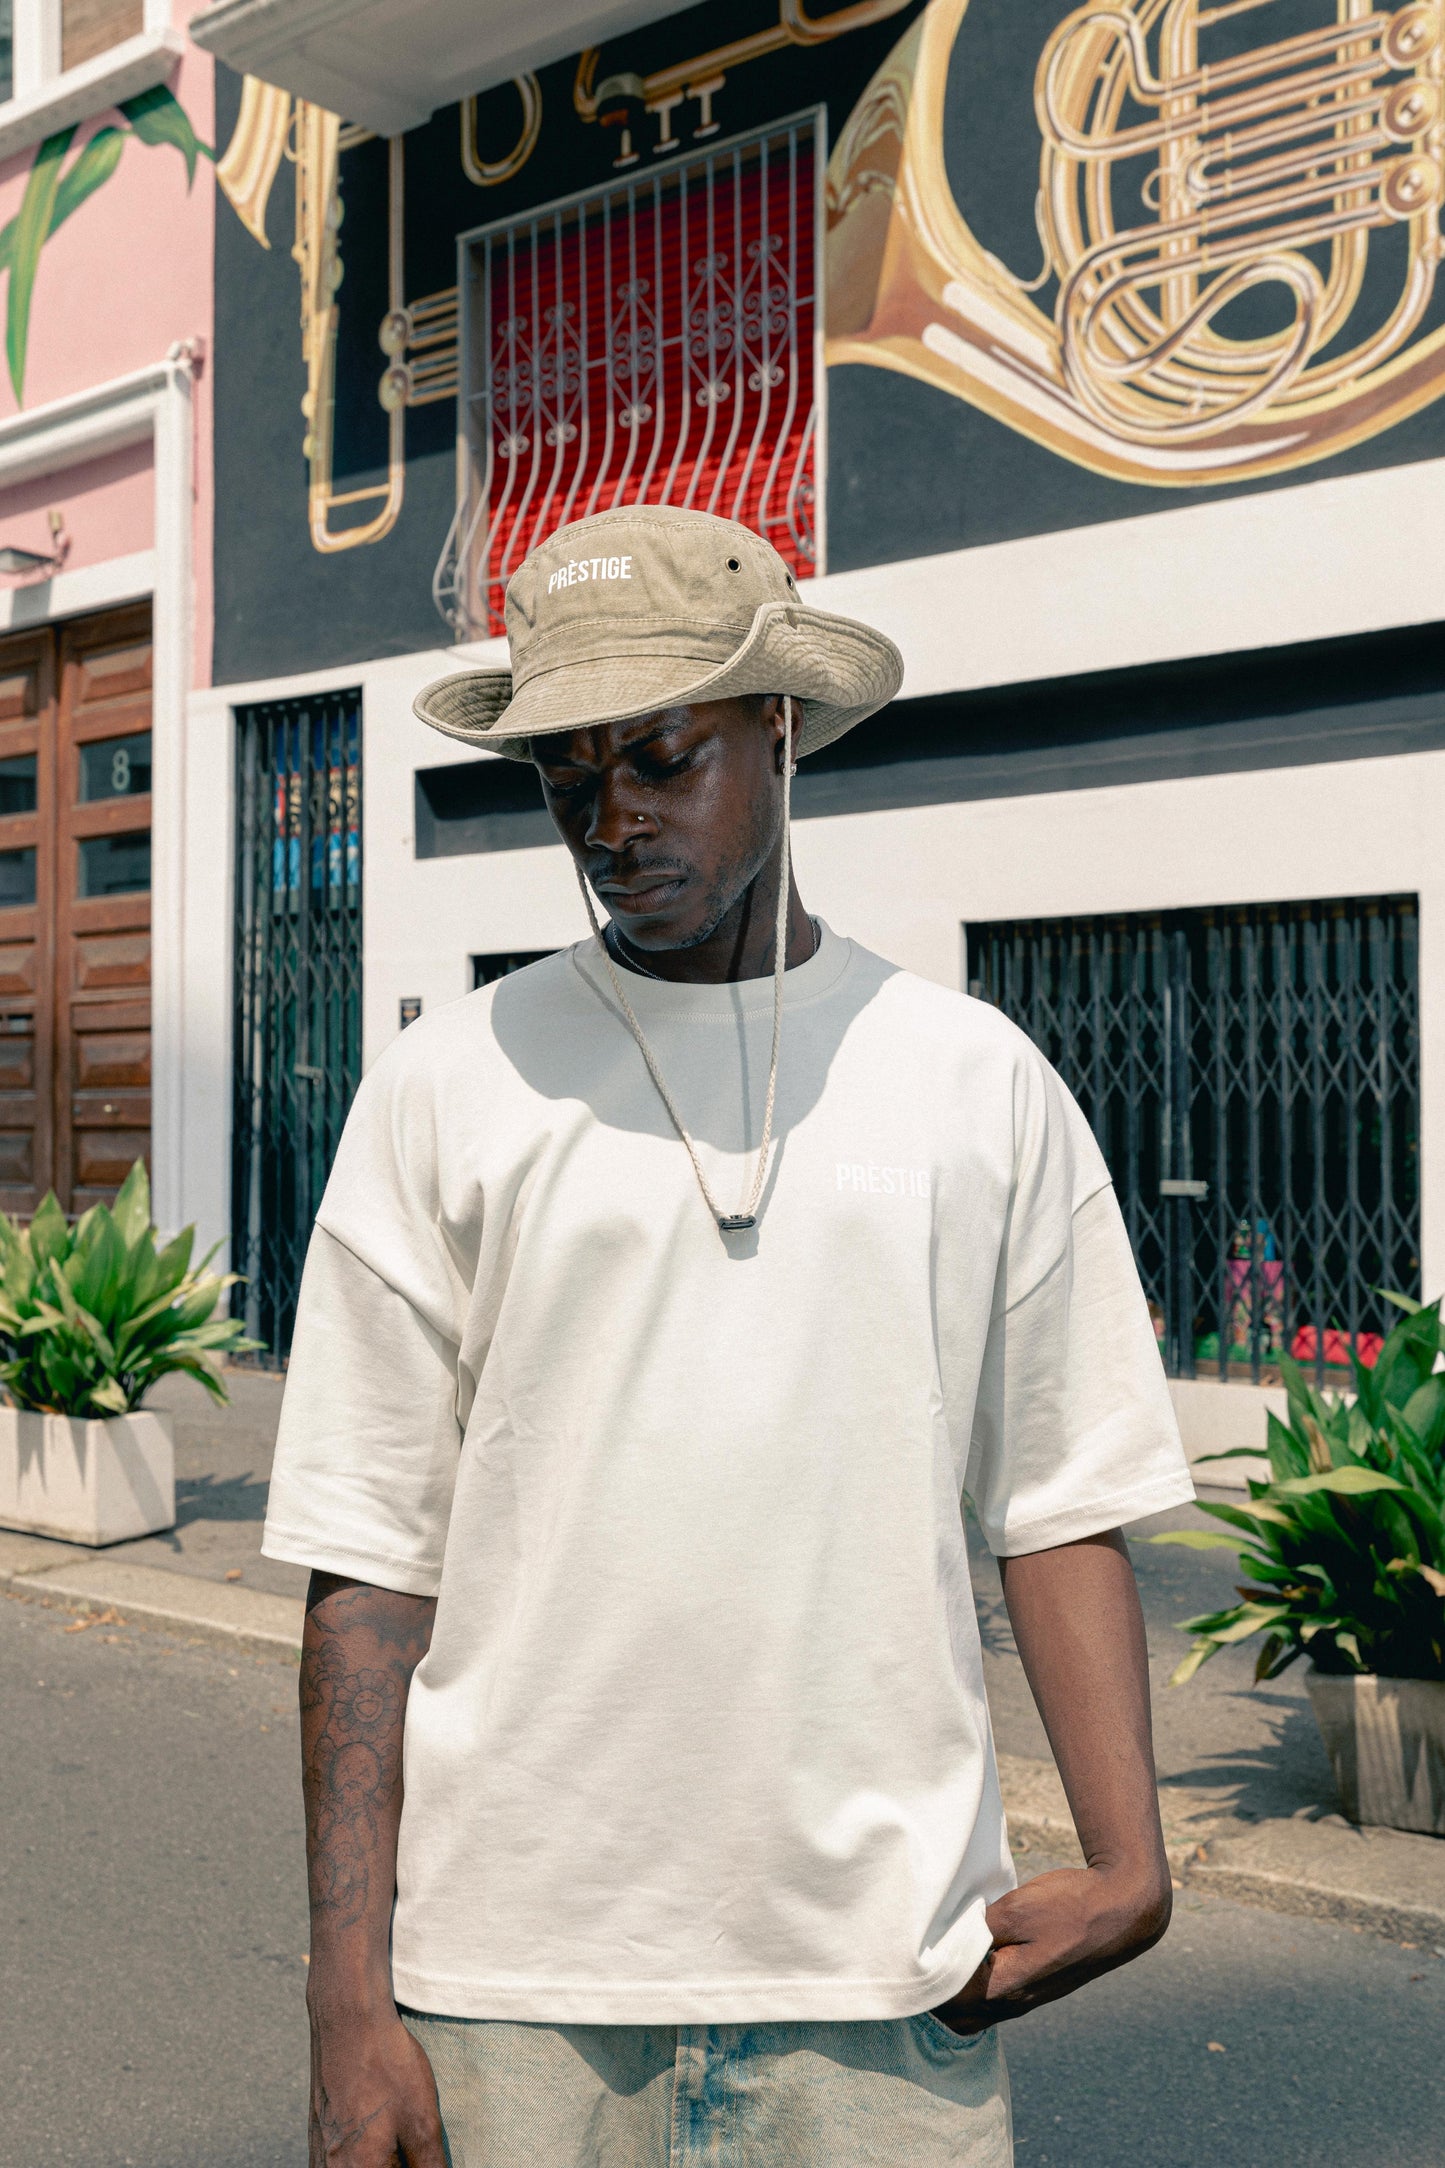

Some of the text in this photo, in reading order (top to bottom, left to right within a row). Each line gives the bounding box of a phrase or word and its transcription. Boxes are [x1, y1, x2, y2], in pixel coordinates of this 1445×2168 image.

[548, 556, 632, 594] PRÈSTIGE
[112, 749, 130, 790] 8
[835, 1160, 931, 1198] PRÈSTIG
